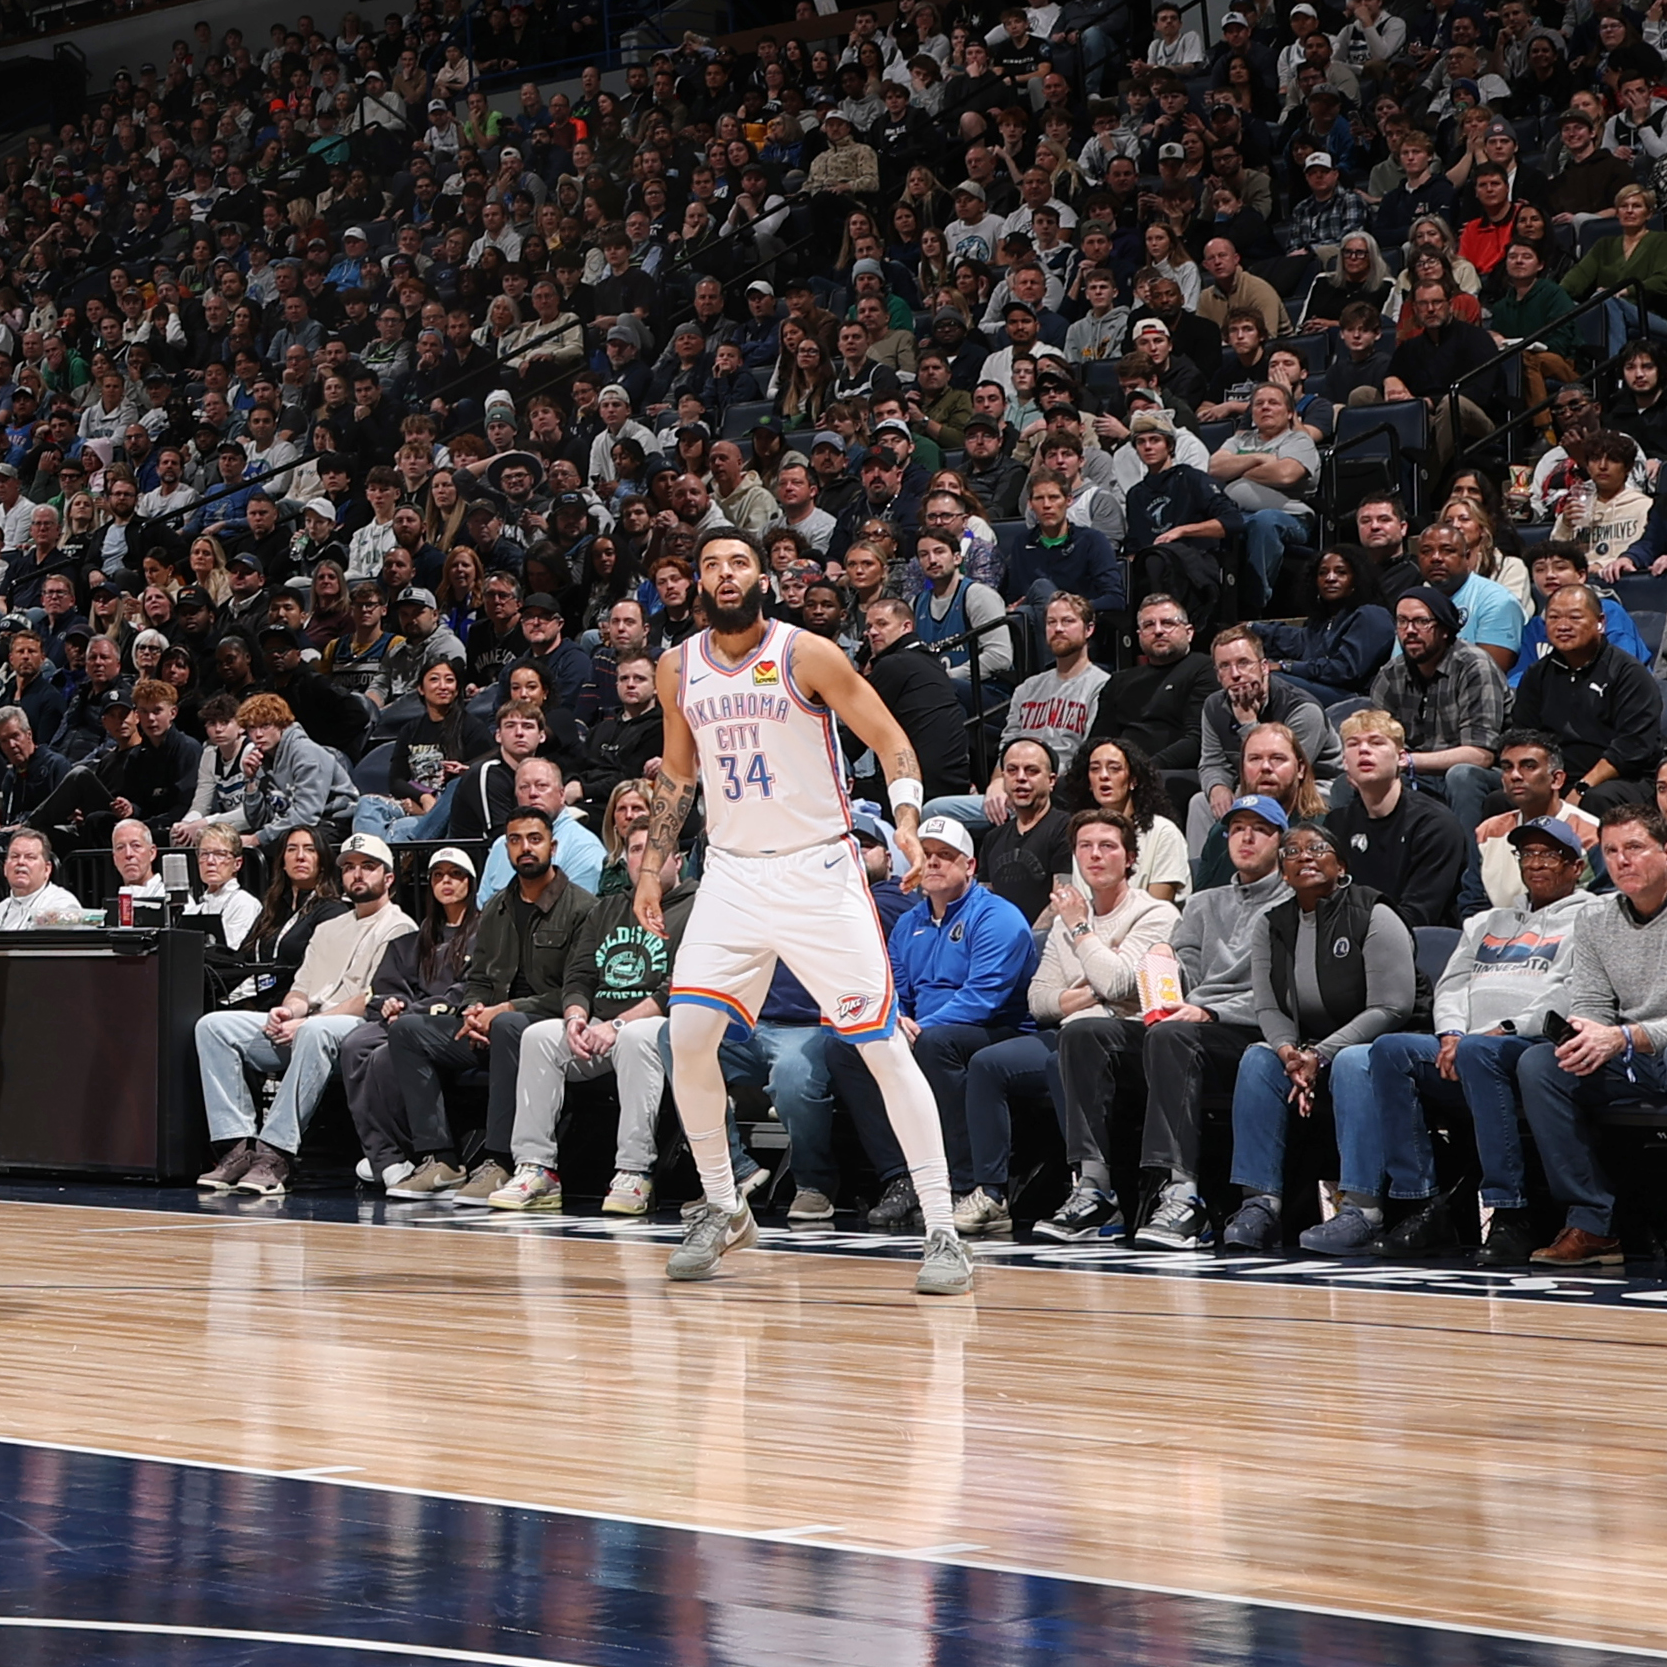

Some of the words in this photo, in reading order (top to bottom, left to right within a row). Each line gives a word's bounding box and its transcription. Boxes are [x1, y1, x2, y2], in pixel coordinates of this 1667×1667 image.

[685, 692, 791, 731] OKLAHOMA
[715, 722, 761, 752] CITY
[715, 751, 776, 803] 34
